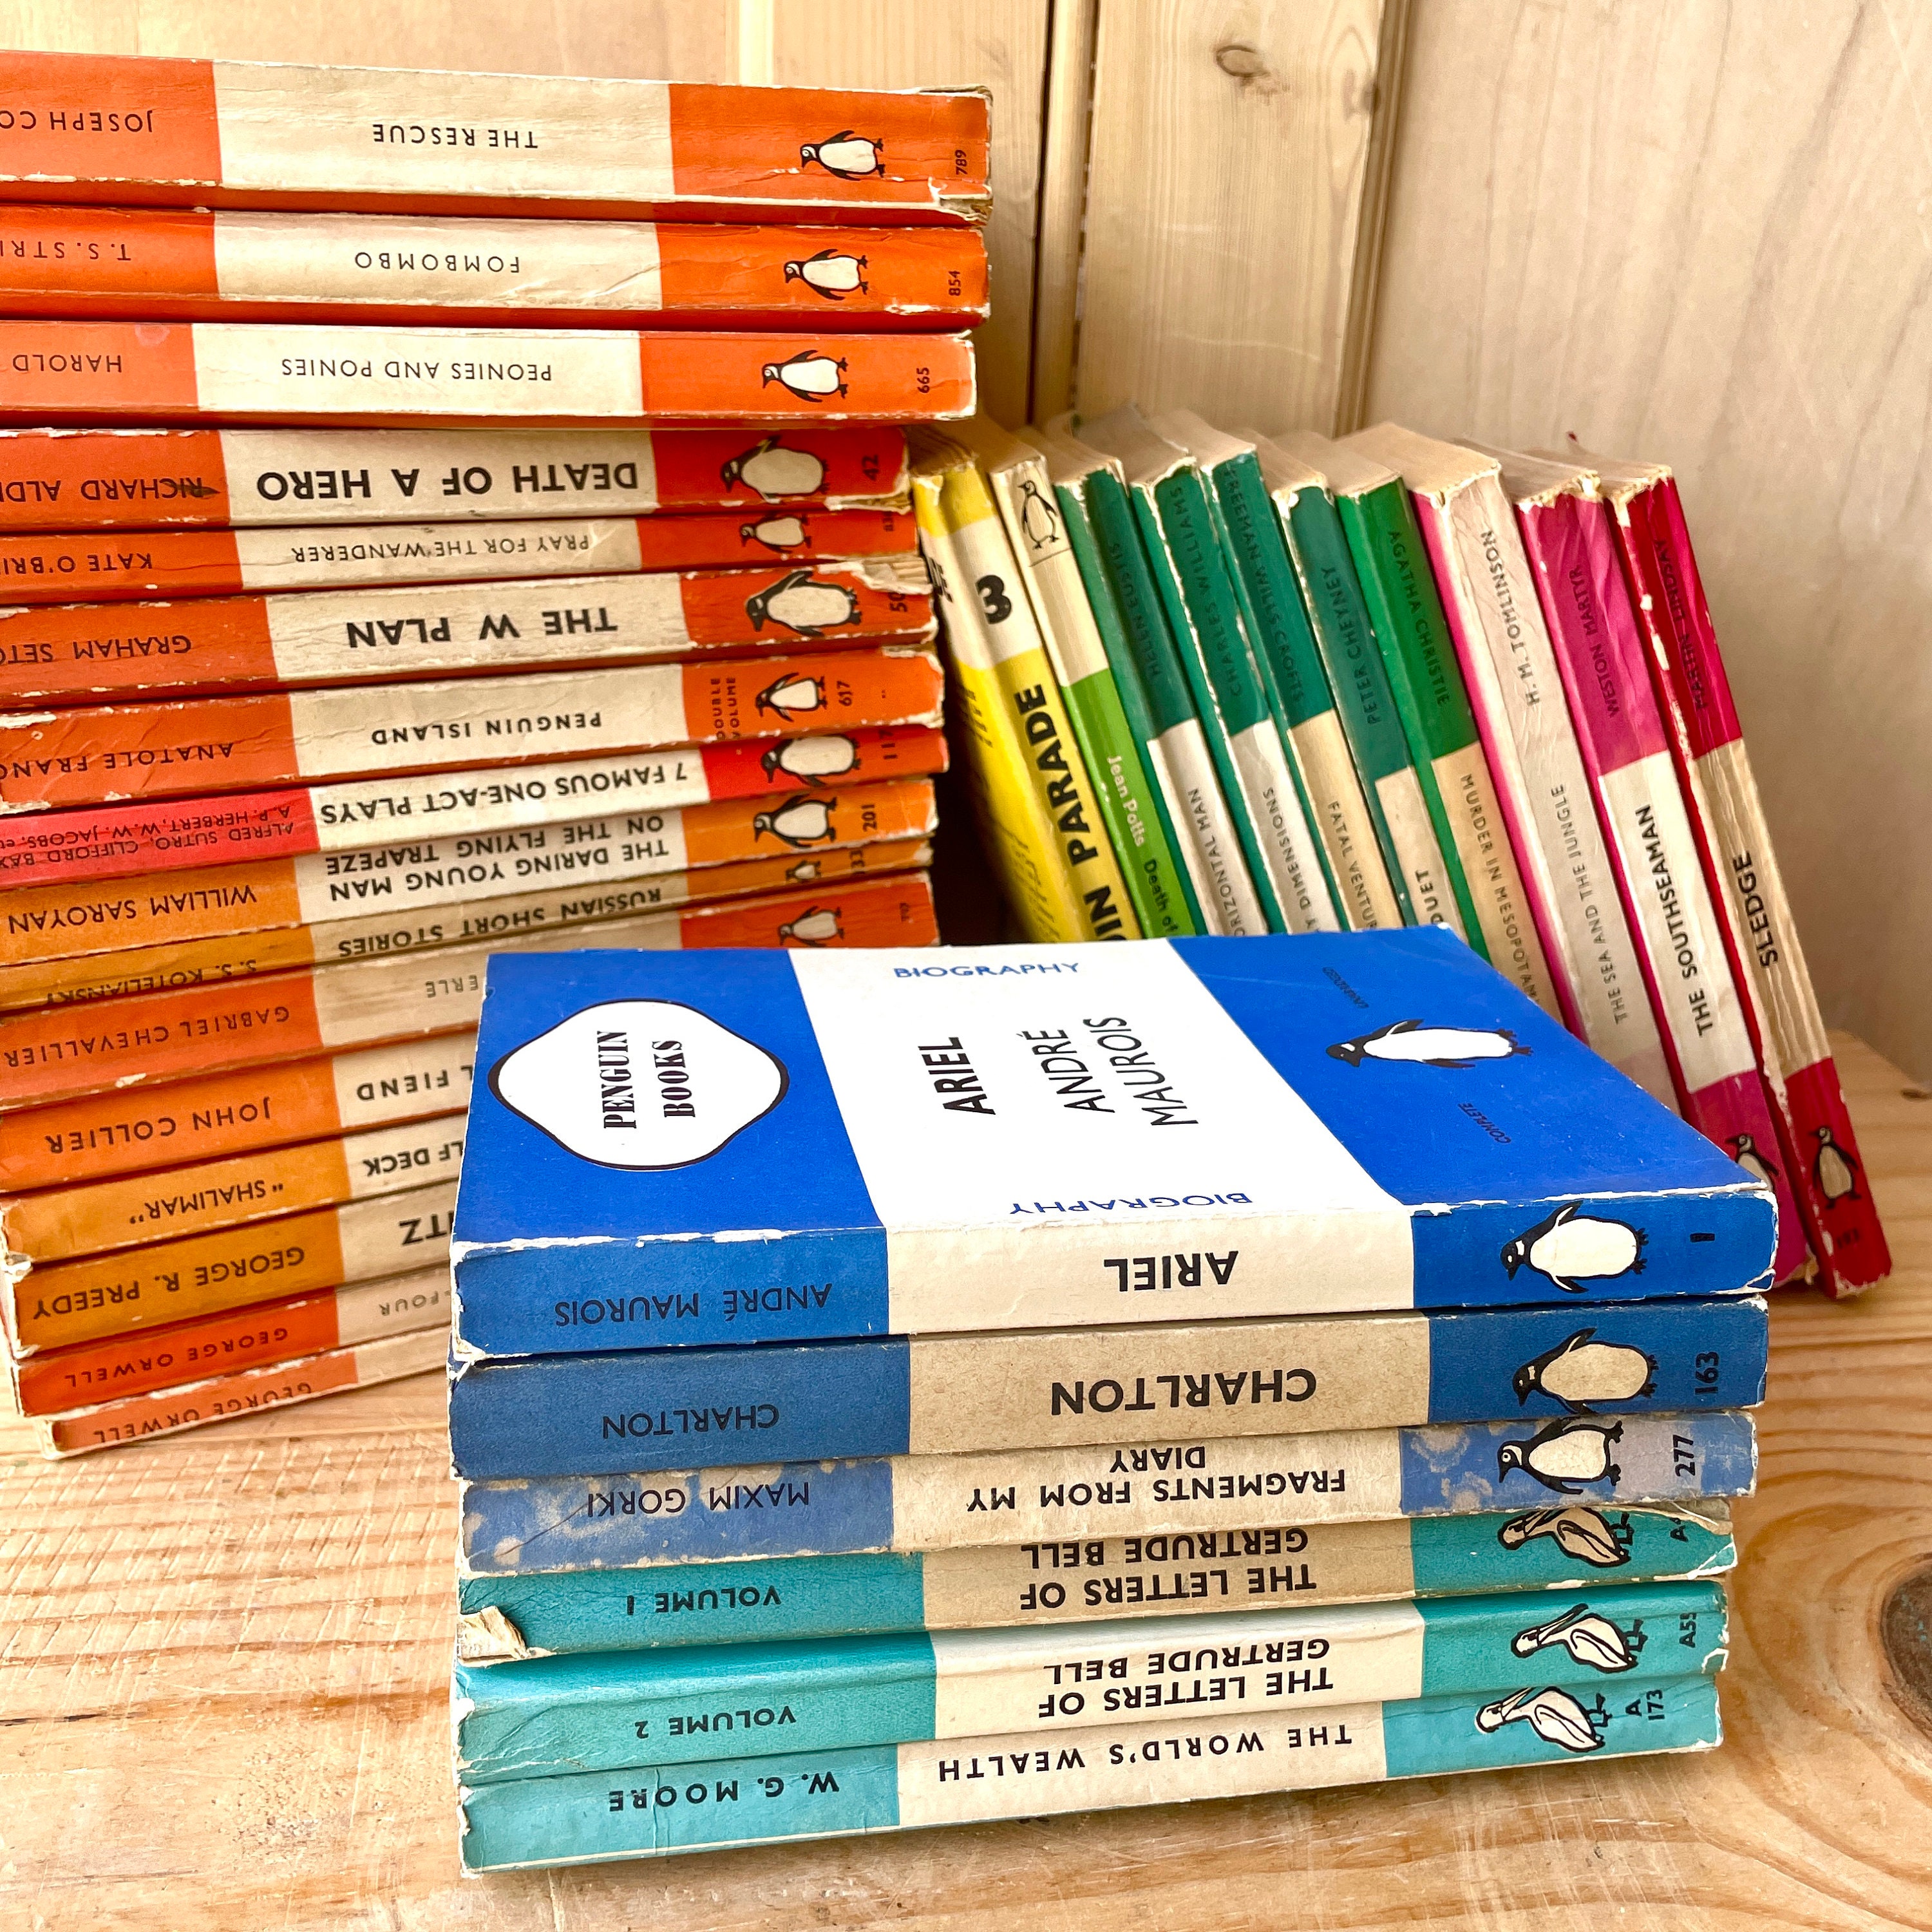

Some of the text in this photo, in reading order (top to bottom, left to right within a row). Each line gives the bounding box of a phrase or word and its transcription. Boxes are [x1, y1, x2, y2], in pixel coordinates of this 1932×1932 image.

[50, 109, 153, 133] JOSEPH
[372, 124, 538, 148] THE RESCUE
[954, 149, 967, 175] 789
[77, 242, 99, 260] S.
[111, 243, 131, 261] T.
[354, 252, 520, 274] FOMBOMBO
[948, 270, 961, 296] 854
[10, 353, 122, 373] HAROLD
[280, 357, 552, 381] PEONIES AND PONIES
[916, 366, 930, 393] 665
[80, 477, 204, 501] RICHARD
[257, 462, 638, 501] DEATH OF A HERO
[861, 455, 879, 482] 42
[88, 553, 152, 572] KATE
[291, 535, 589, 563] PRAY FOR THE WANDERER
[976, 574, 1012, 624] 3
[1170, 486, 1242, 697] CHARLES WILLIAMS
[346, 607, 617, 648] THE W PLAN
[1388, 530, 1450, 705] AGATHA CHRISTIE
[1481, 529, 1540, 706] H. TOMLINSON
[73, 636, 191, 659] GRAHAM
[1321, 567, 1381, 724] PETER CHEYNEY
[1569, 565, 1619, 717] WESTON MARTYR
[1274, 632, 1304, 701] CROFTS
[837, 681, 853, 706] 617
[372, 712, 601, 745] PENGUIN ISLAND
[104, 743, 234, 769] ANATOLE
[1014, 684, 1098, 867] PARADE
[321, 762, 687, 824] 7 FAMOUS ONE-ACT PLAYS
[1188, 788, 1213, 831] MAN
[229, 822, 294, 840] ALFRED
[862, 805, 877, 831] 201
[1106, 756, 1171, 912] Jean Potts Death
[1328, 800, 1354, 857] FATAL
[1460, 773, 1502, 882] MURDER IN
[48, 840, 138, 862] CLIFFORD
[325, 816, 663, 875] ON THE FLYING TRAPEZE
[1263, 786, 1311, 911] DIMENSIONS
[330, 840, 668, 902] THE DARING YOUNG MAN
[8, 884, 257, 934] WILLIAM SAROYAN
[338, 888, 661, 958] RUSSIAN SHORT STORIES
[1551, 784, 1627, 1025] THE SEA AND THE JUNGLE
[1635, 804, 1713, 1037] THE SOUTHSEAMAN
[1733, 850, 1779, 969] SLEDGE
[894, 963, 1079, 978] BIOGRAPHY
[5, 1006, 289, 1068] GABRIEL CHEVALLIER
[356, 1069, 449, 1101] FIEND
[597, 1030, 636, 1129] PENGUIN
[652, 1039, 696, 1118] BOOKS
[918, 1037, 996, 1115] ARIEL
[1016, 1029, 1115, 1113] ANDRÉ
[1083, 1016, 1198, 1126] MAUROIS
[44, 1097, 270, 1154] JOHN COLLIER
[1458, 1102, 1511, 1144] COMPLETE
[363, 1148, 430, 1177] DECK
[1009, 1193, 1253, 1215] BIOGRAPHY
[33, 1247, 305, 1319] GEORGE R. PREEDY
[1104, 1251, 1238, 1292] ARIEL
[554, 1284, 832, 1327] ANDRÉ MAUROIS
[64, 1327, 289, 1388] GEORGE ORWELL
[1695, 1352, 1719, 1394] 163
[93, 1382, 312, 1444] GEORGE ORWELL
[1051, 1368, 1317, 1416] CHARLTON
[602, 1404, 779, 1439] CHARLTON
[1110, 1446, 1206, 1473] DIARY
[1672, 1435, 1696, 1477] 277
[588, 1482, 810, 1517] MAXIM GORKI
[967, 1470, 1345, 1511] FRAGMENTS FROM MY
[1021, 1528, 1308, 1569] GERTRUDE BELL
[655, 1586, 781, 1613] VOLUME
[1020, 1564, 1316, 1610] THE LETTERS OF
[1043, 1638, 1330, 1685] GERTRUDE BELL
[1038, 1667, 1333, 1718] THE LETTERS OF
[1625, 1699, 1642, 1716] A
[1646, 1690, 1665, 1720] 173
[635, 1705, 796, 1739] VOLUME 2
[939, 1725, 1352, 1782] THE WORLD'S WEALTH
[609, 1772, 838, 1812] W. G. MOORE
